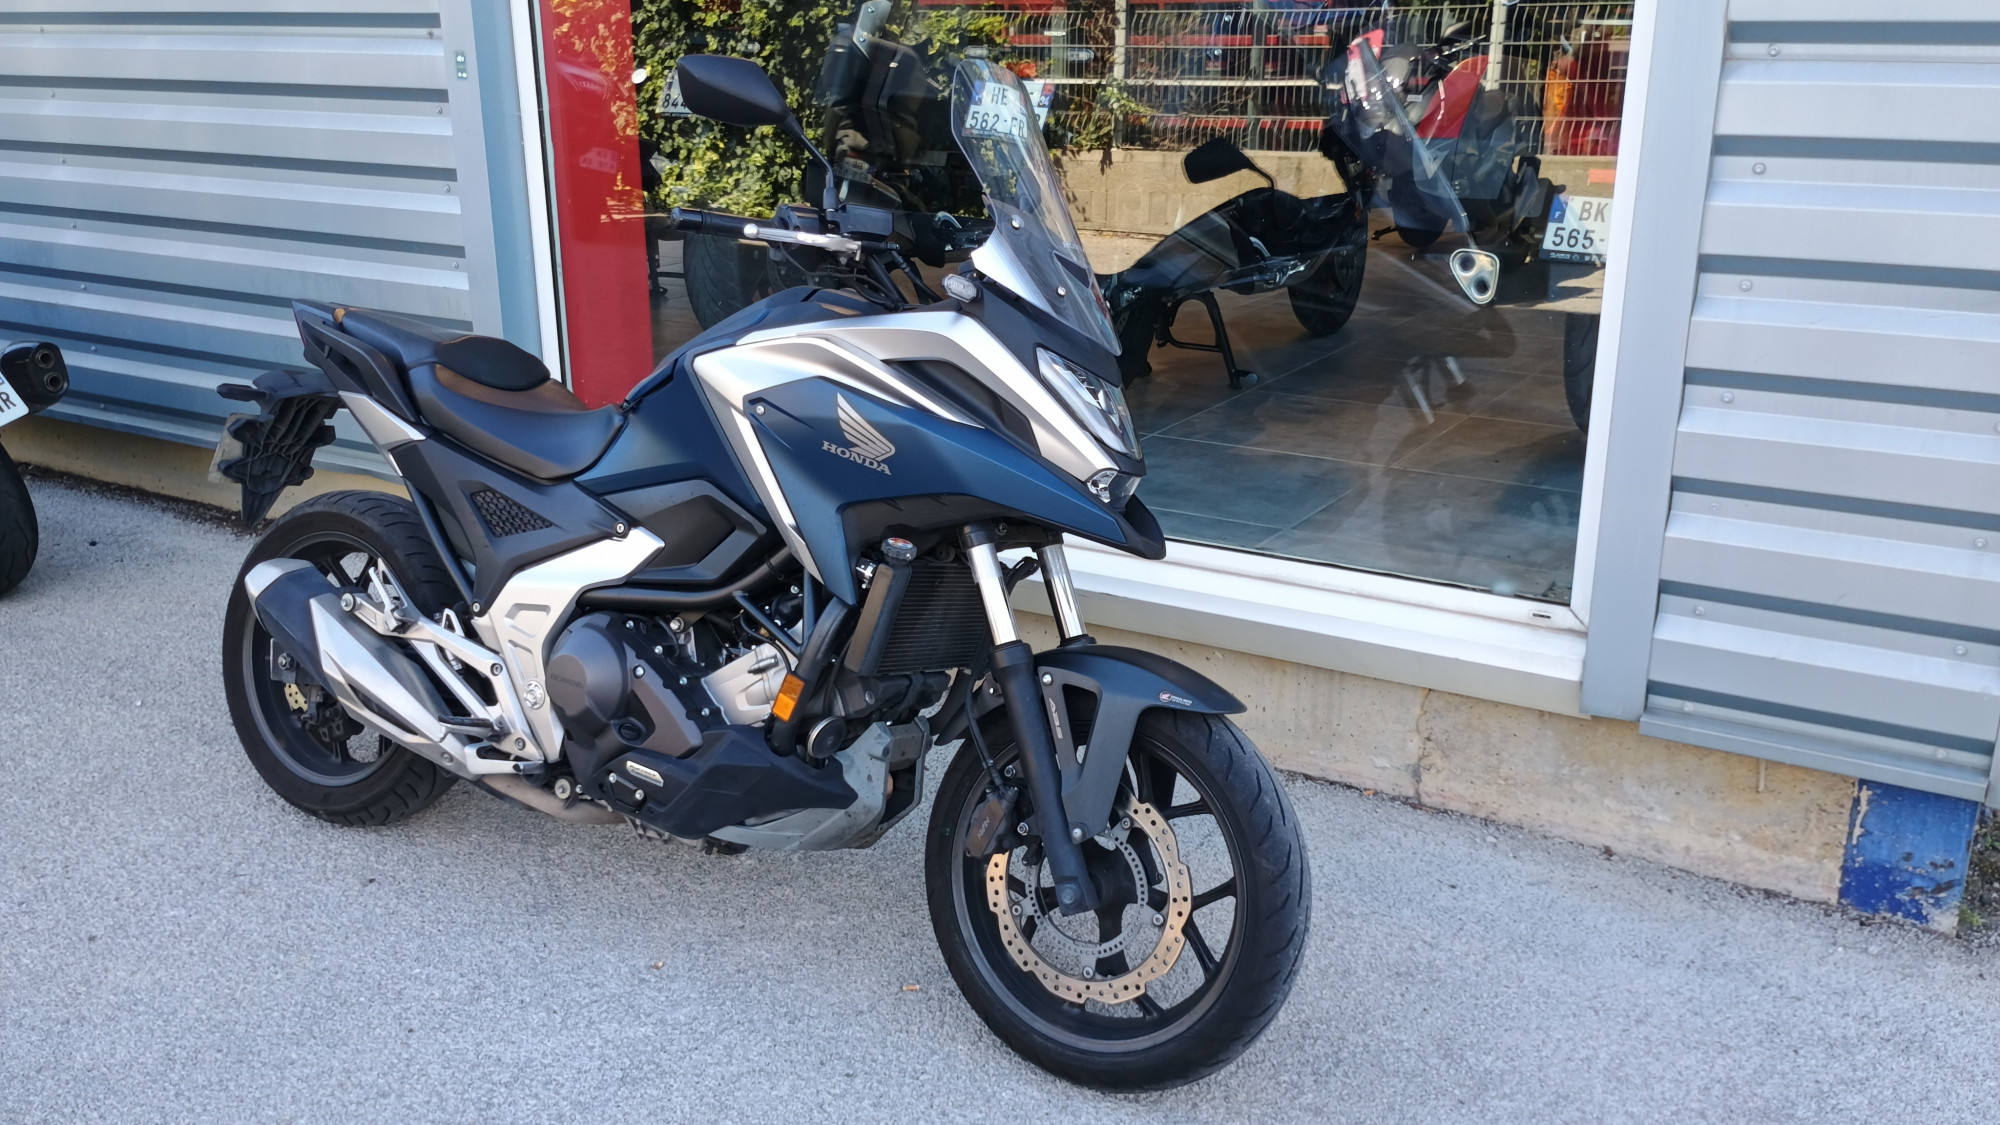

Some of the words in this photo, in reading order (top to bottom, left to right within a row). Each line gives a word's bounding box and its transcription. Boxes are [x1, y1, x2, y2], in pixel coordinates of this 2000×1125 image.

[991, 86, 1009, 106] HE
[1579, 200, 1608, 223] BK
[821, 440, 892, 476] HONDA
[1049, 697, 1064, 739] ABS
